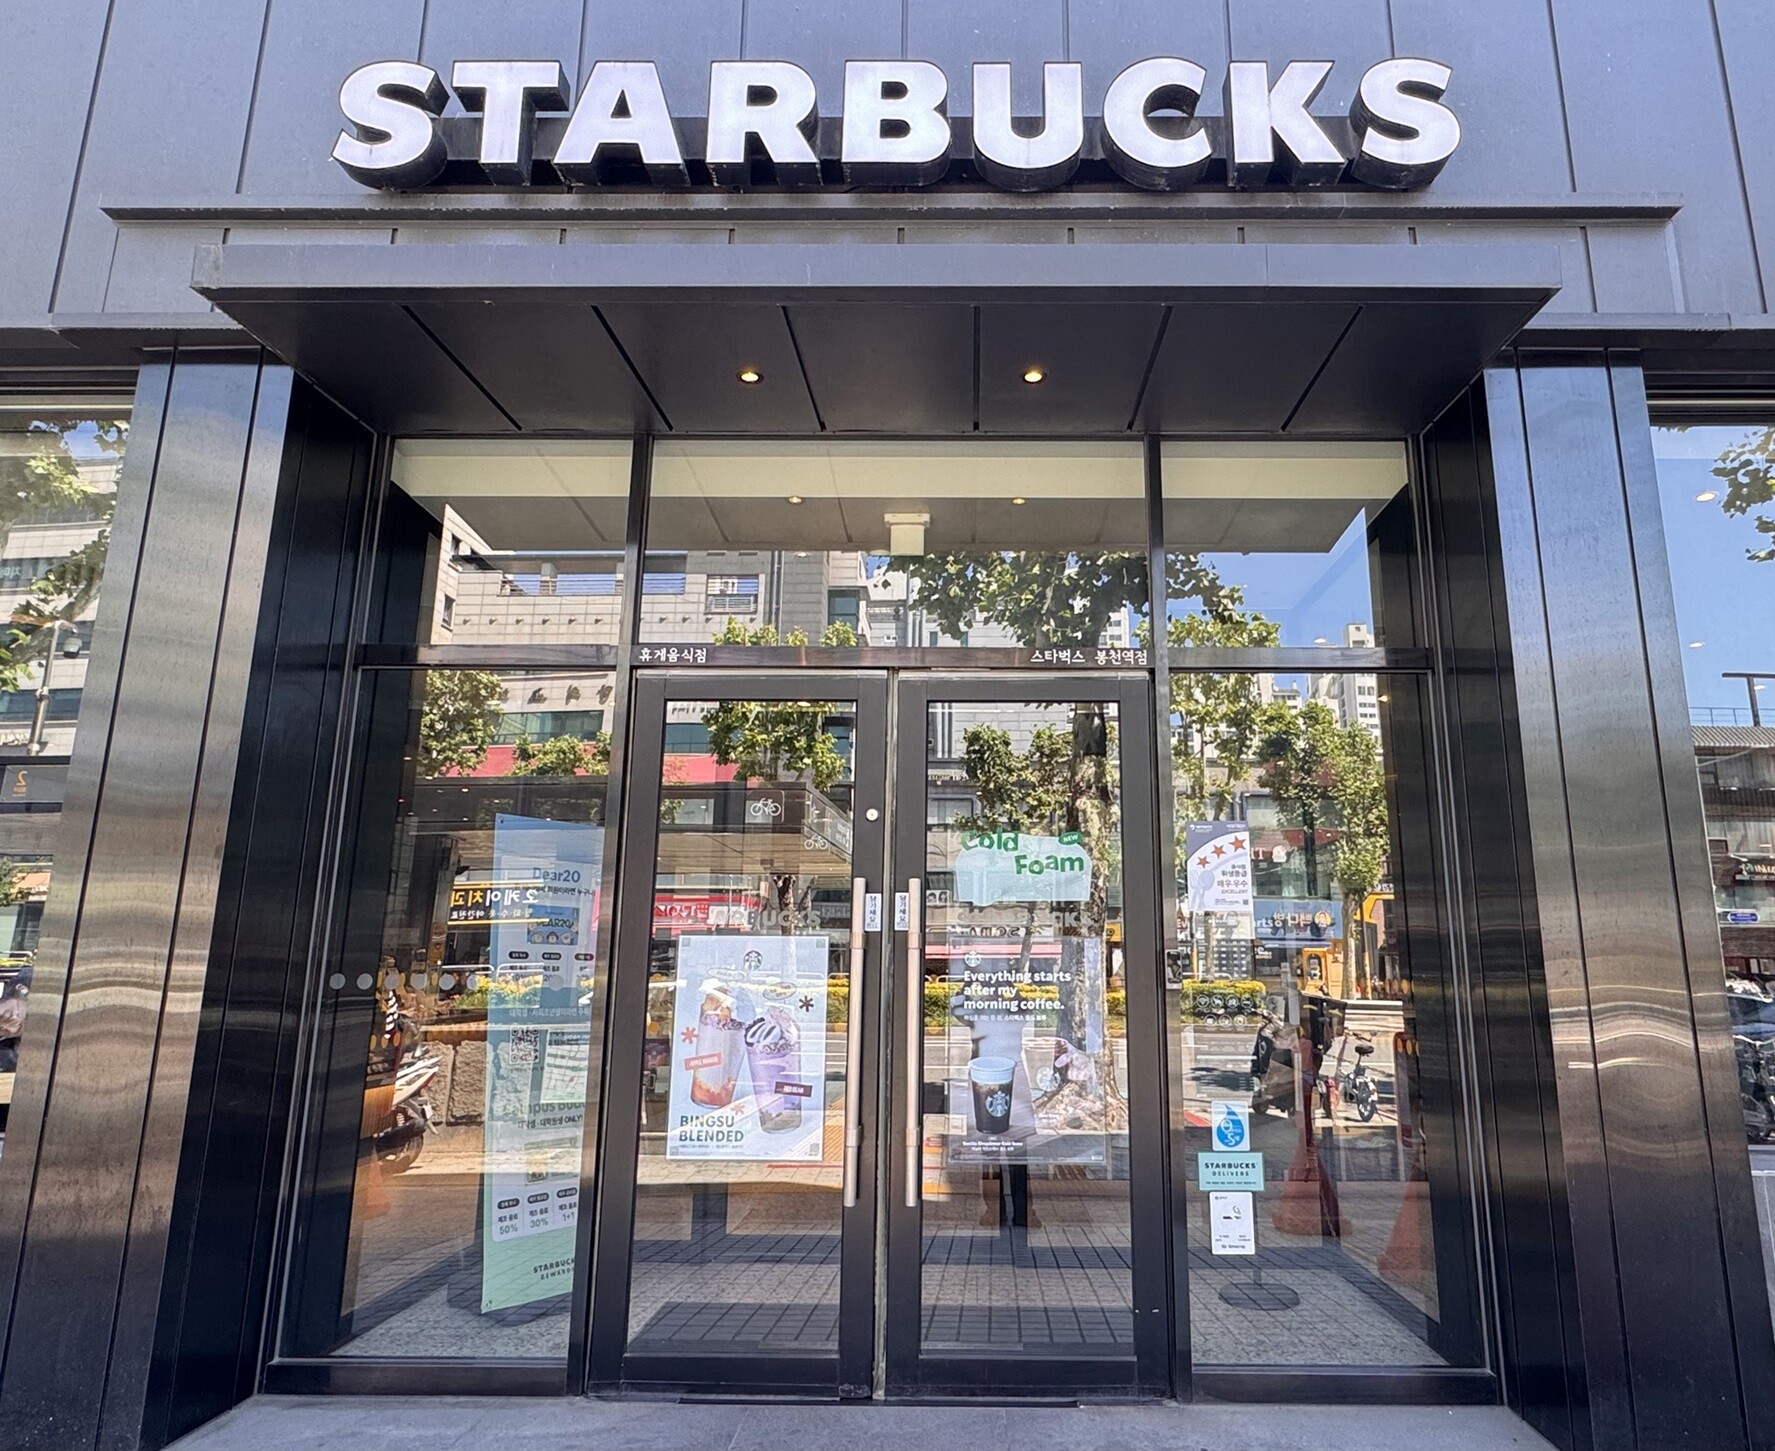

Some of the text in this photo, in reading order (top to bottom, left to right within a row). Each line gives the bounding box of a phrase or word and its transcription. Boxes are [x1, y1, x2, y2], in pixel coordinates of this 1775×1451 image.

[330, 56, 1463, 172] STARBUCKS
[638, 647, 707, 663] 휴게음식점
[1030, 649, 1148, 666] 스타벅스 봉천역점
[961, 827, 1019, 852] Cold
[1063, 834, 1079, 843] NEW
[1014, 854, 1085, 875] Foam
[533, 867, 581, 883] Dear20
[963, 970, 1072, 984] Everything starts
[963, 984, 1018, 998] after my
[963, 998, 1065, 1011] morning coffee.
[680, 1115, 735, 1128] BINGSU
[679, 1130, 745, 1143] BLENDED
[499, 1223, 519, 1235] 50%
[529, 1217, 549, 1229] 30%
[540, 1267, 575, 1280] REWARD
